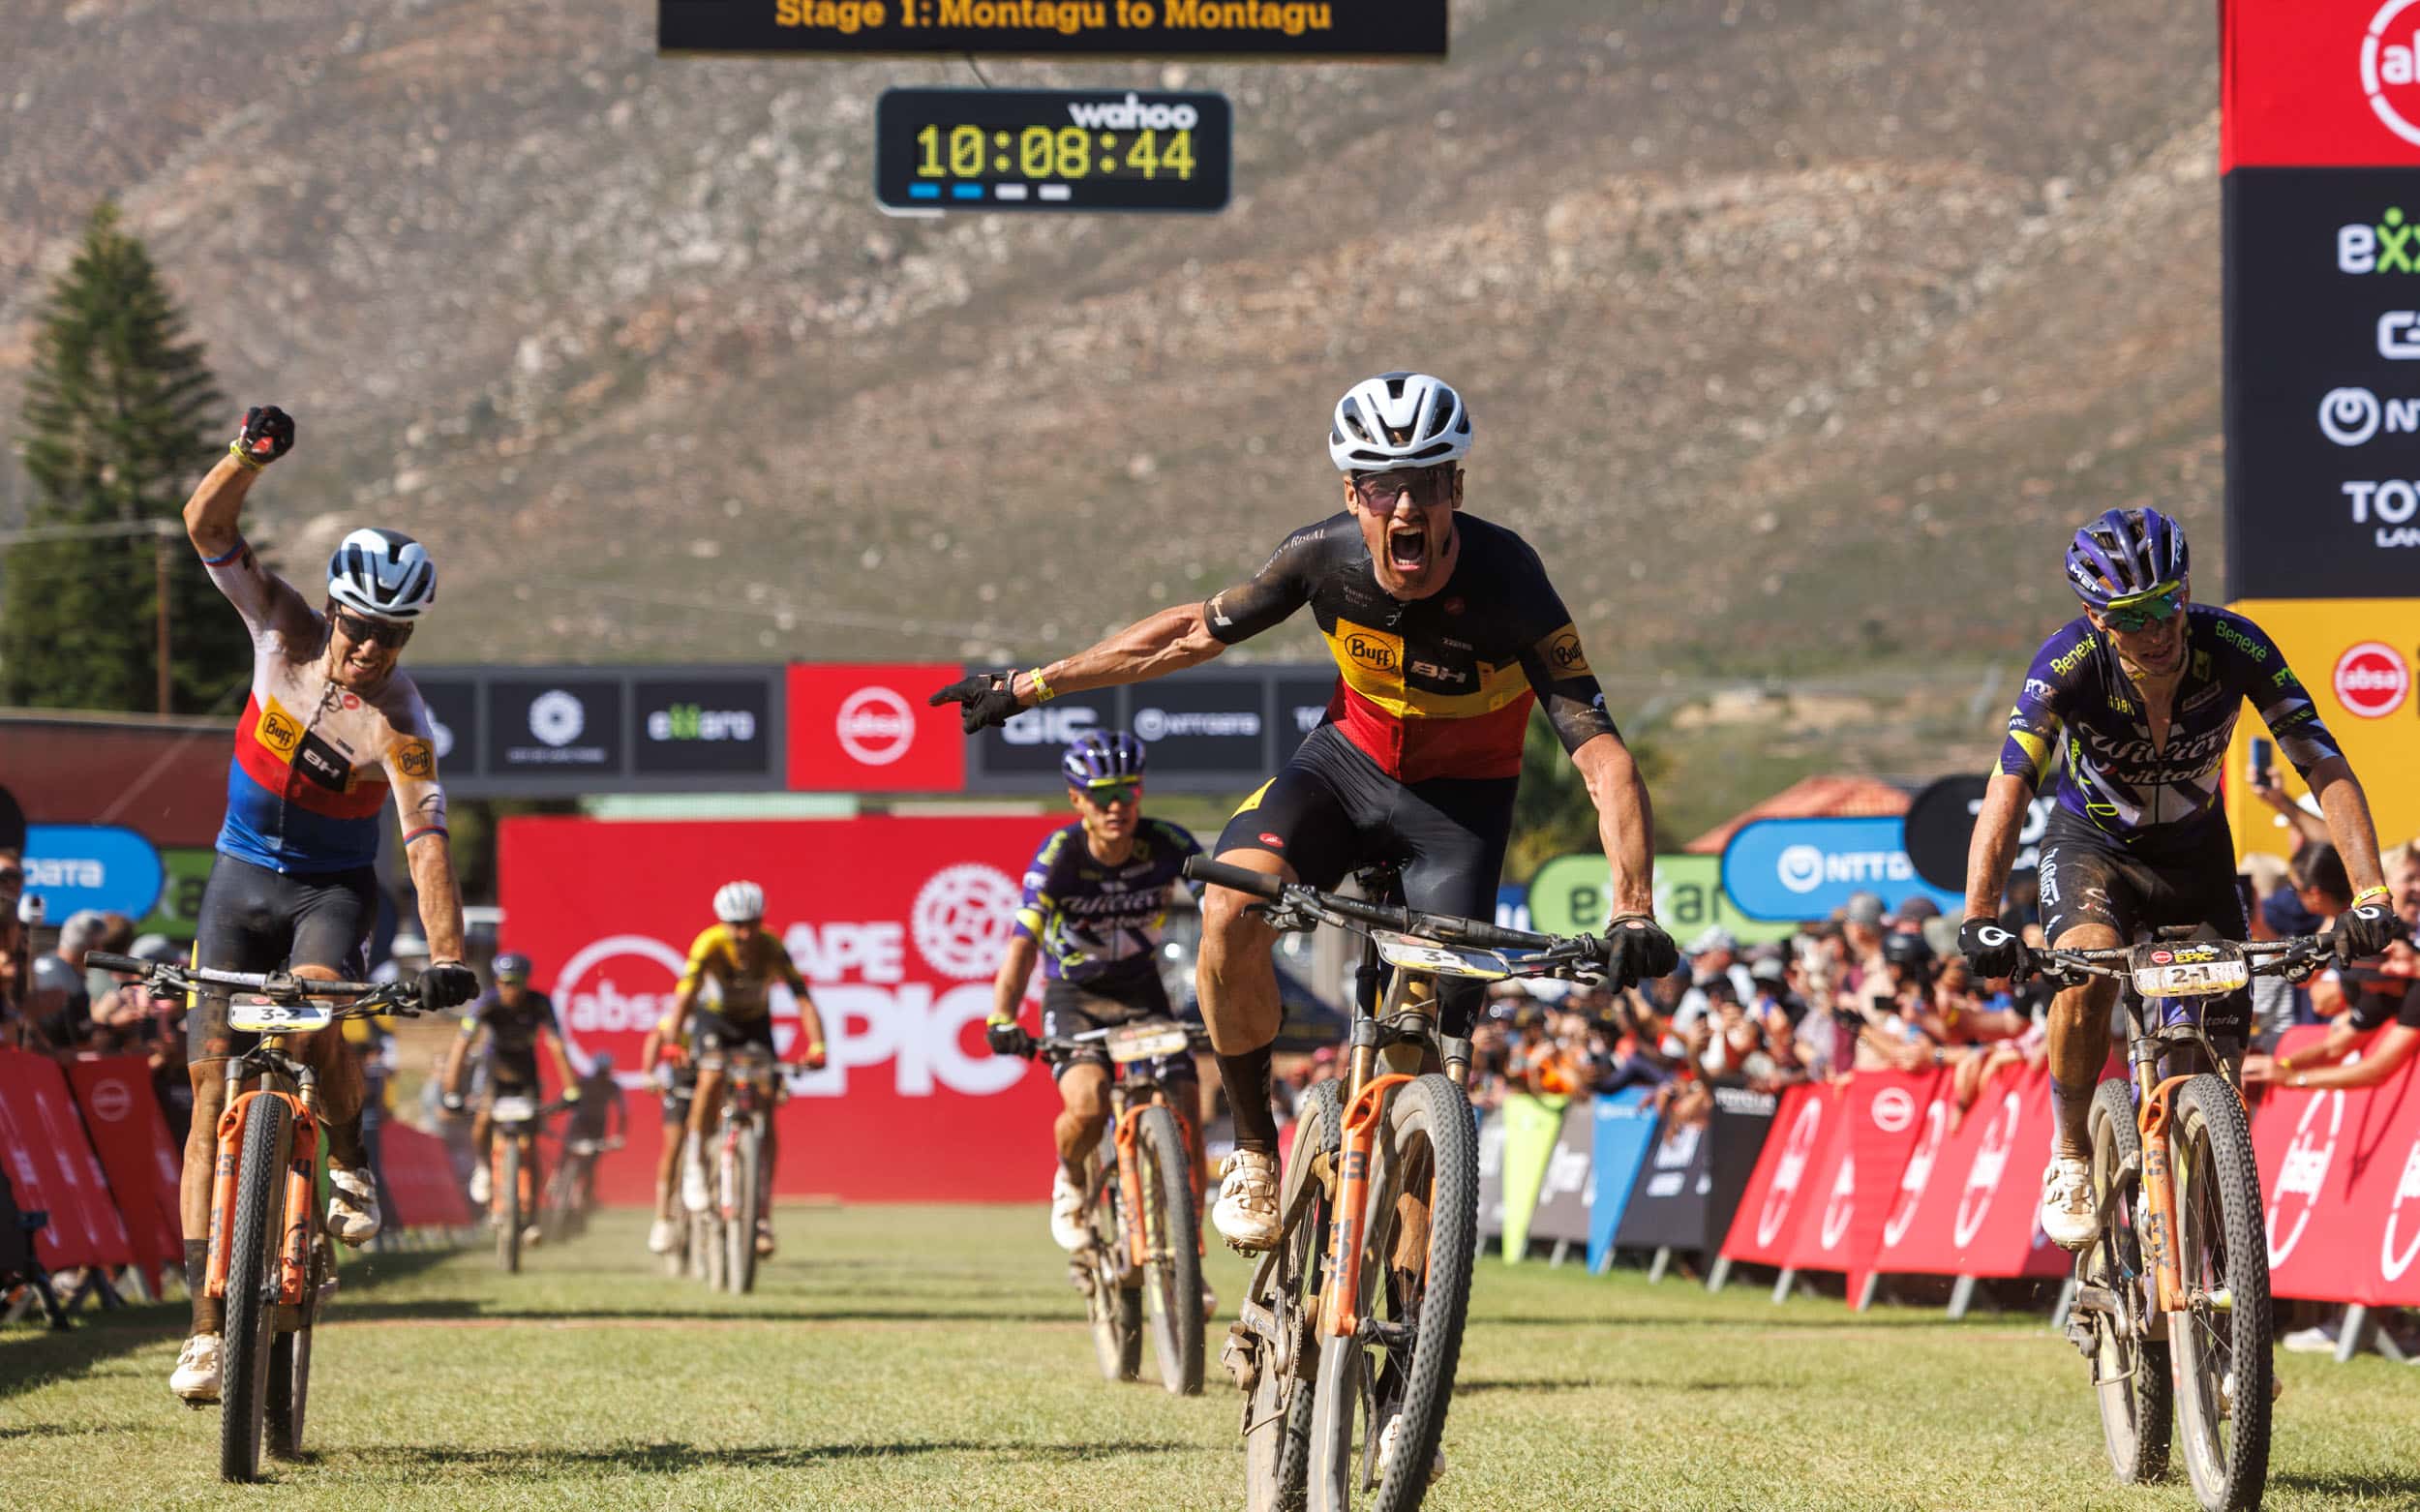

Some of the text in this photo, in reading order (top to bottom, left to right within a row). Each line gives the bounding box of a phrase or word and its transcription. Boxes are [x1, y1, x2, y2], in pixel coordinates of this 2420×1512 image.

[775, 0, 885, 33] Stage
[937, 0, 1106, 35] Montagu
[1117, 0, 1154, 27] to
[1165, 0, 1332, 36] Montagu
[1069, 94, 1197, 130] wahoo
[917, 126, 1196, 180] 10:08:44
[2342, 479, 2420, 524] TO
[2070, 563, 2102, 593] MET
[1351, 639, 1391, 667] Buff
[1410, 660, 1467, 683] BH
[264, 714, 294, 745] Buff
[302, 748, 341, 778] BH
[401, 749, 432, 771] Buff
[786, 922, 905, 983] APE
[2174, 953, 2216, 964] EPIC
[2170, 966, 2211, 984] 2-1
[259, 1008, 302, 1020] 3-2
